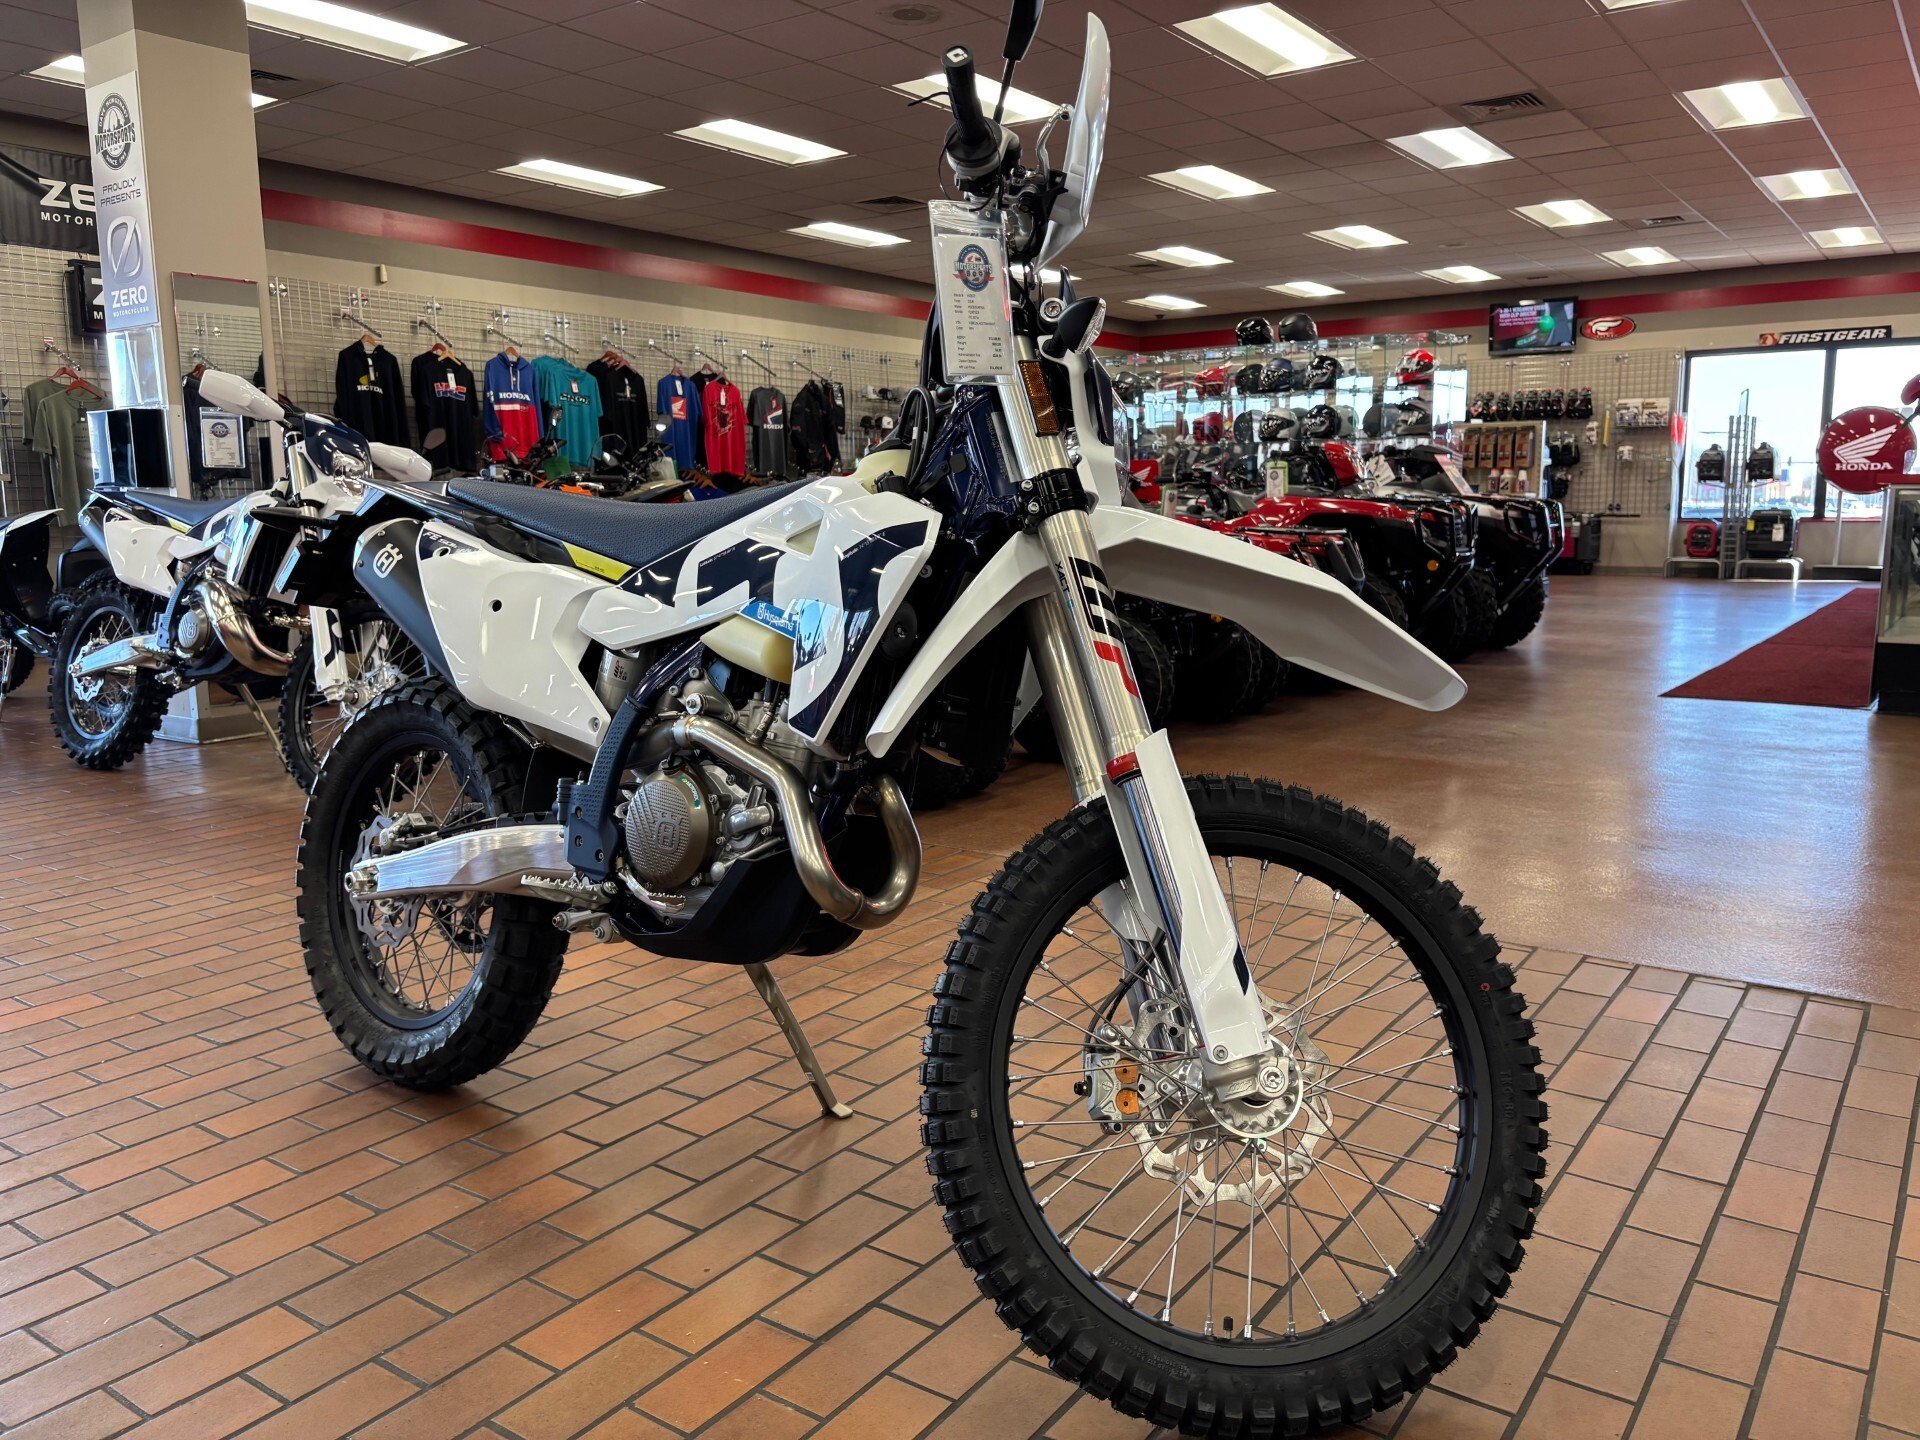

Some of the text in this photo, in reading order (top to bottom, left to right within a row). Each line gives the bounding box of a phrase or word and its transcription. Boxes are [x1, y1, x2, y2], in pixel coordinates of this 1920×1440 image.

[94, 122, 137, 154] MOTORSPORTS
[102, 176, 137, 194] PROUDLY
[100, 189, 141, 207] PRESENTS
[111, 285, 148, 308] ZERO
[1778, 327, 1887, 345] FIRSTGEAR
[499, 392, 531, 401] HONDA
[1834, 462, 1894, 471] HONDA
[423, 531, 442, 541] FE
[1055, 560, 1070, 593] XACT
